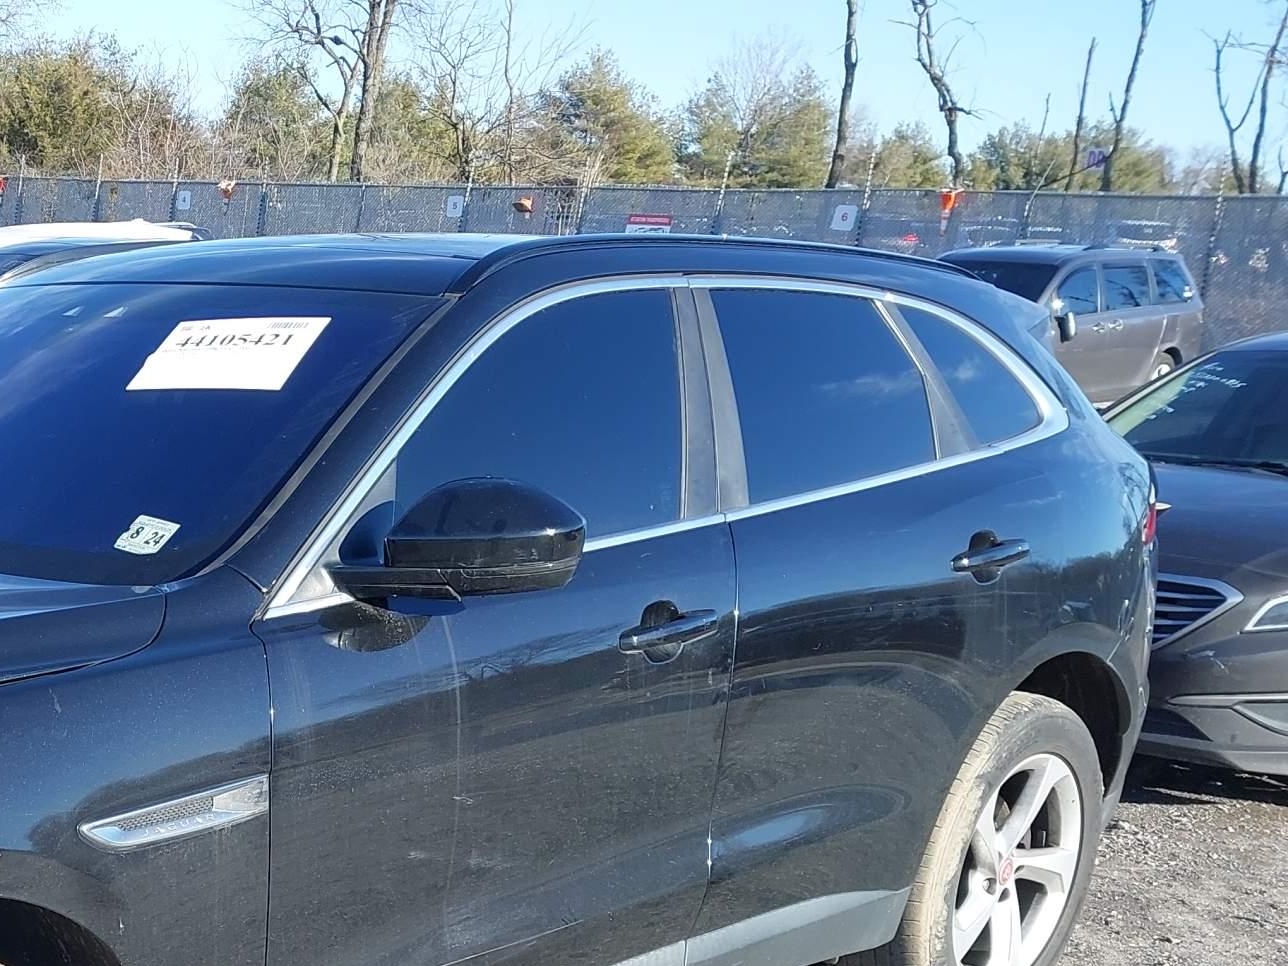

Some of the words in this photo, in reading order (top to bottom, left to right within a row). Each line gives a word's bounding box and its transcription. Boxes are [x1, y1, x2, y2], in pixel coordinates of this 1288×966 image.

[841, 211, 849, 222] 6
[175, 333, 295, 348] 44105421
[129, 525, 145, 540] 8
[143, 531, 166, 547] 24
[143, 813, 214, 838] JAGUAR
